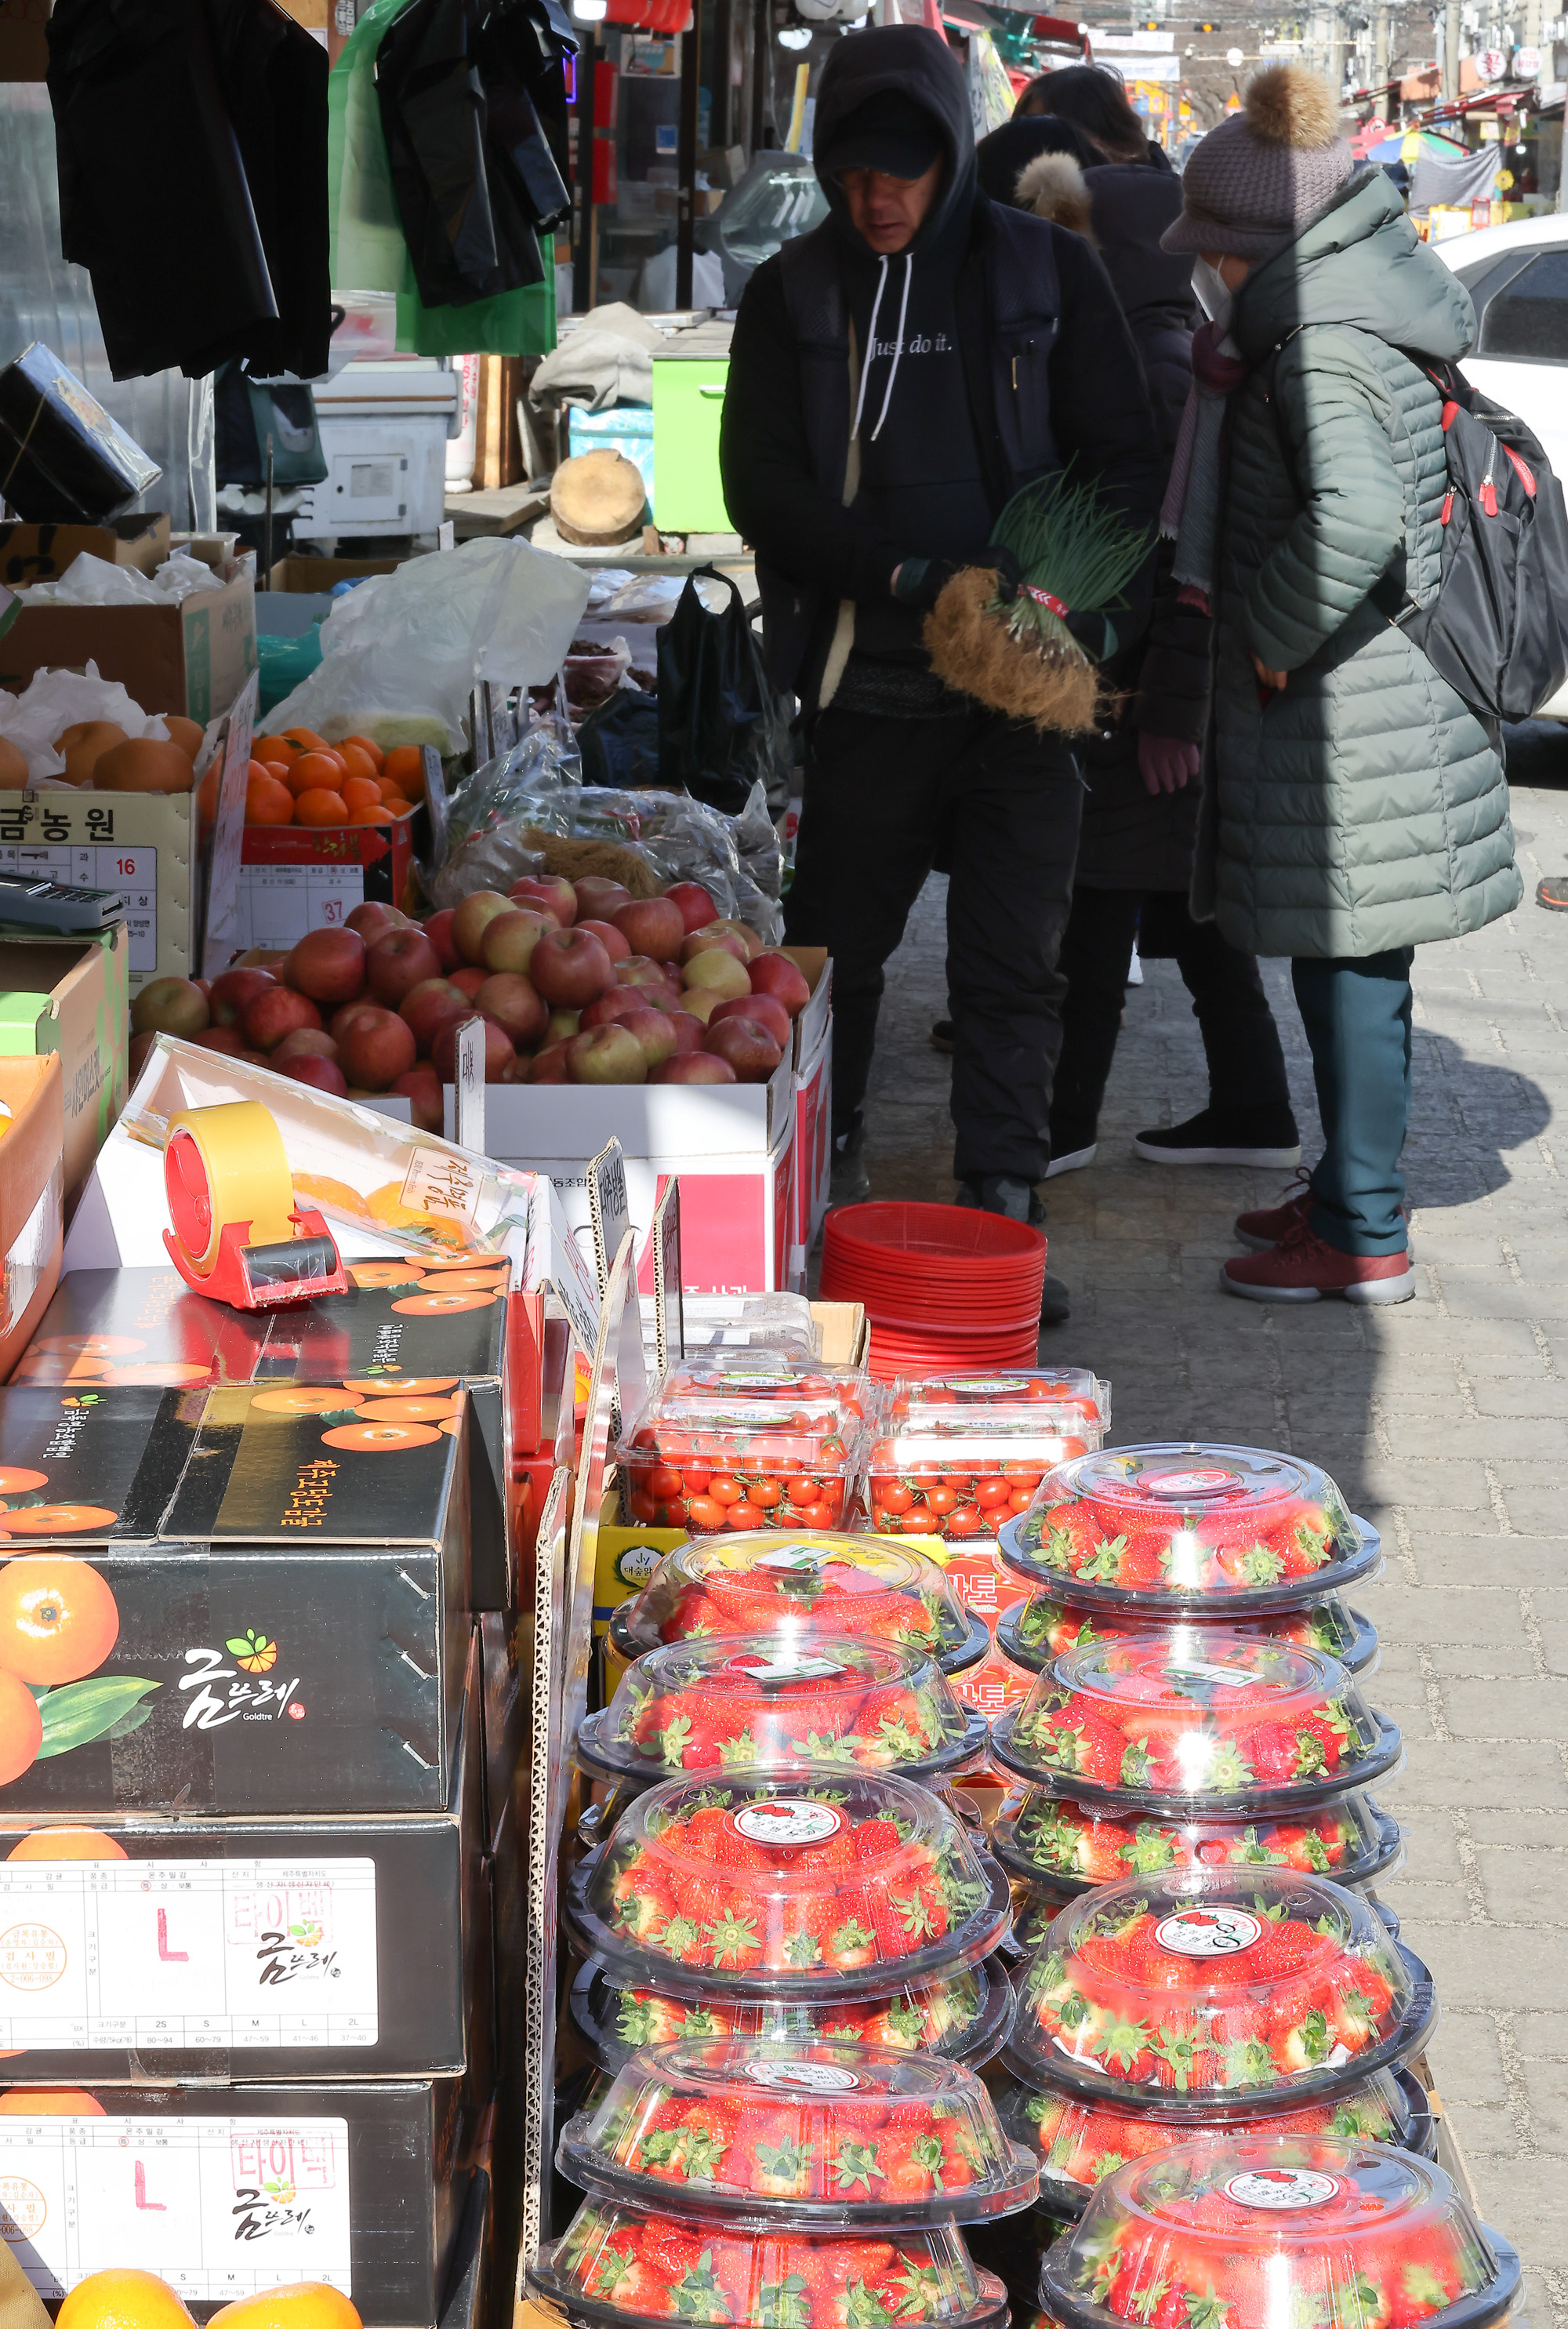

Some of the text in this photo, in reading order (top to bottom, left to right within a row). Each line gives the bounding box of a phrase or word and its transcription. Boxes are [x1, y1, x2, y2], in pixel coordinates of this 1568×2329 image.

[909, 334, 931, 353] do
[935, 332, 952, 351] it.
[117, 858, 136, 875] 16
[325, 901, 343, 921] 37
[280, 1459, 341, 1528] 제주고당도감귤
[242, 1712, 274, 1721] Goldtre
[158, 1908, 189, 1960] L
[135, 2160, 166, 2210] L
